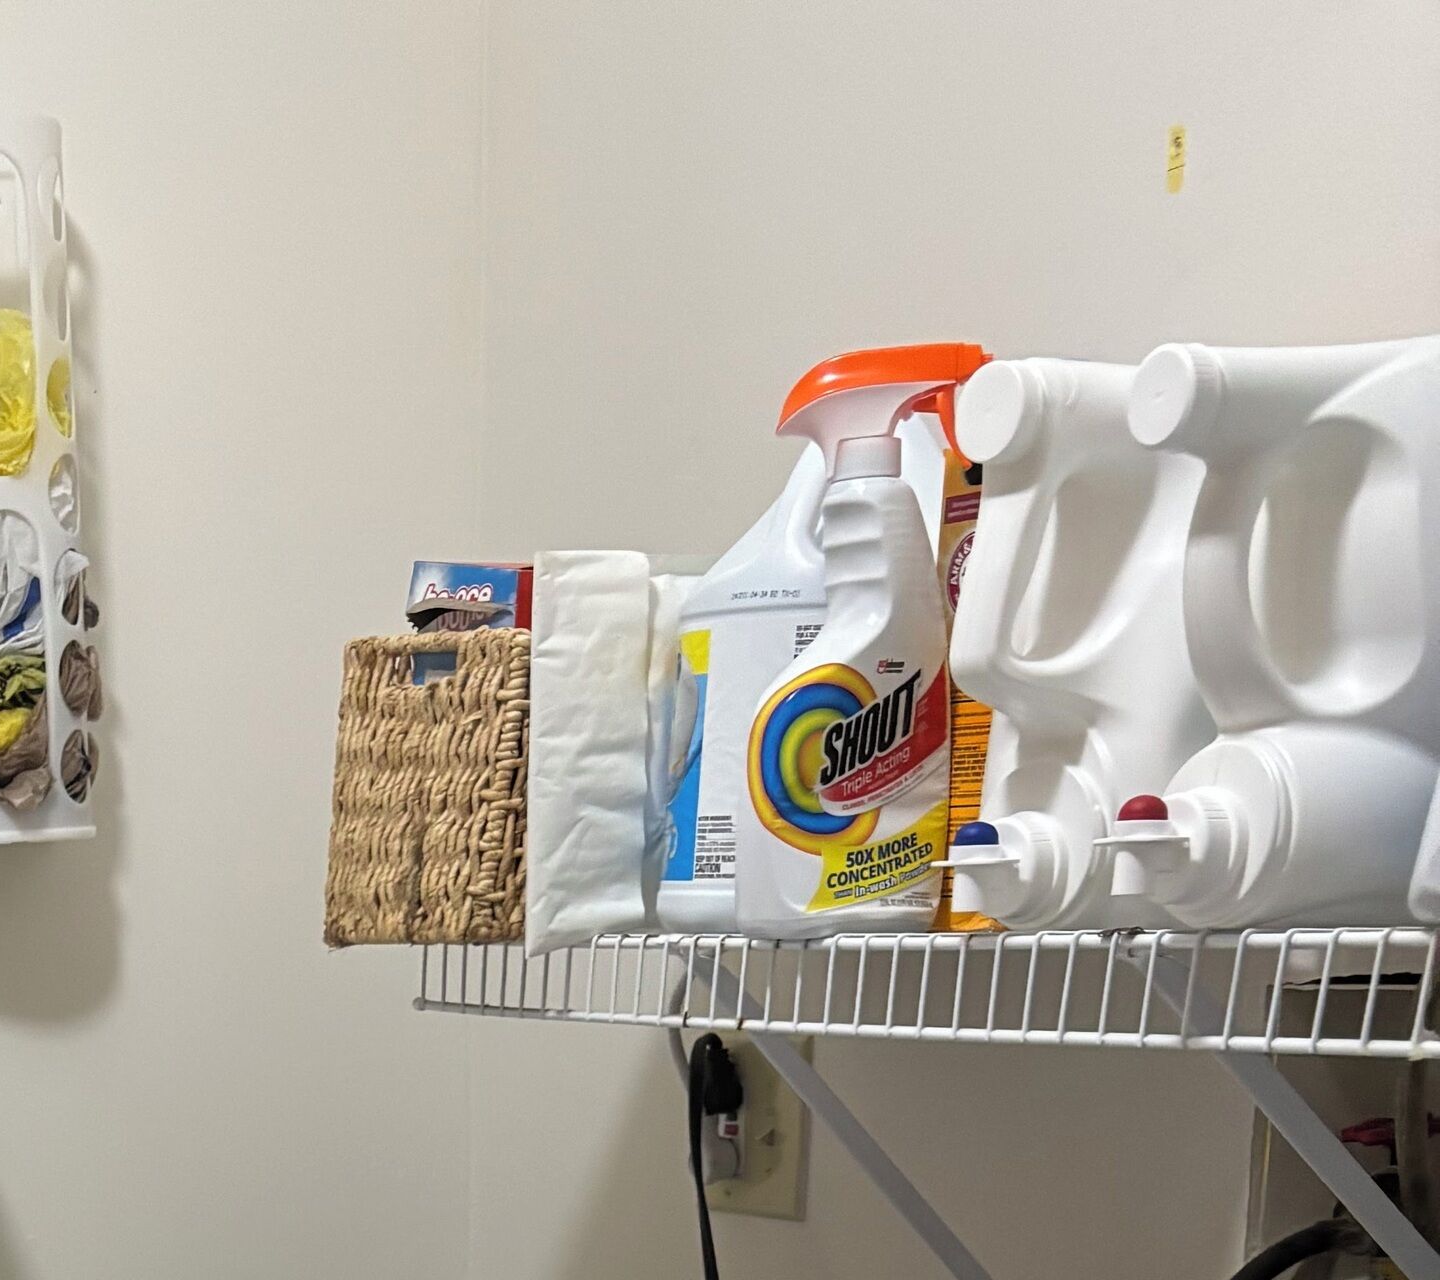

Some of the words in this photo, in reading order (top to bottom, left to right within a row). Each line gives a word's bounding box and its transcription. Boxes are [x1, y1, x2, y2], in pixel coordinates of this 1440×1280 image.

[819, 669, 922, 786] SHOUT
[842, 770, 873, 798] Triple
[875, 745, 910, 776] Acting
[826, 842, 934, 889] CONCENTRATED
[845, 846, 876, 868] 50X
[876, 832, 918, 861] MORE
